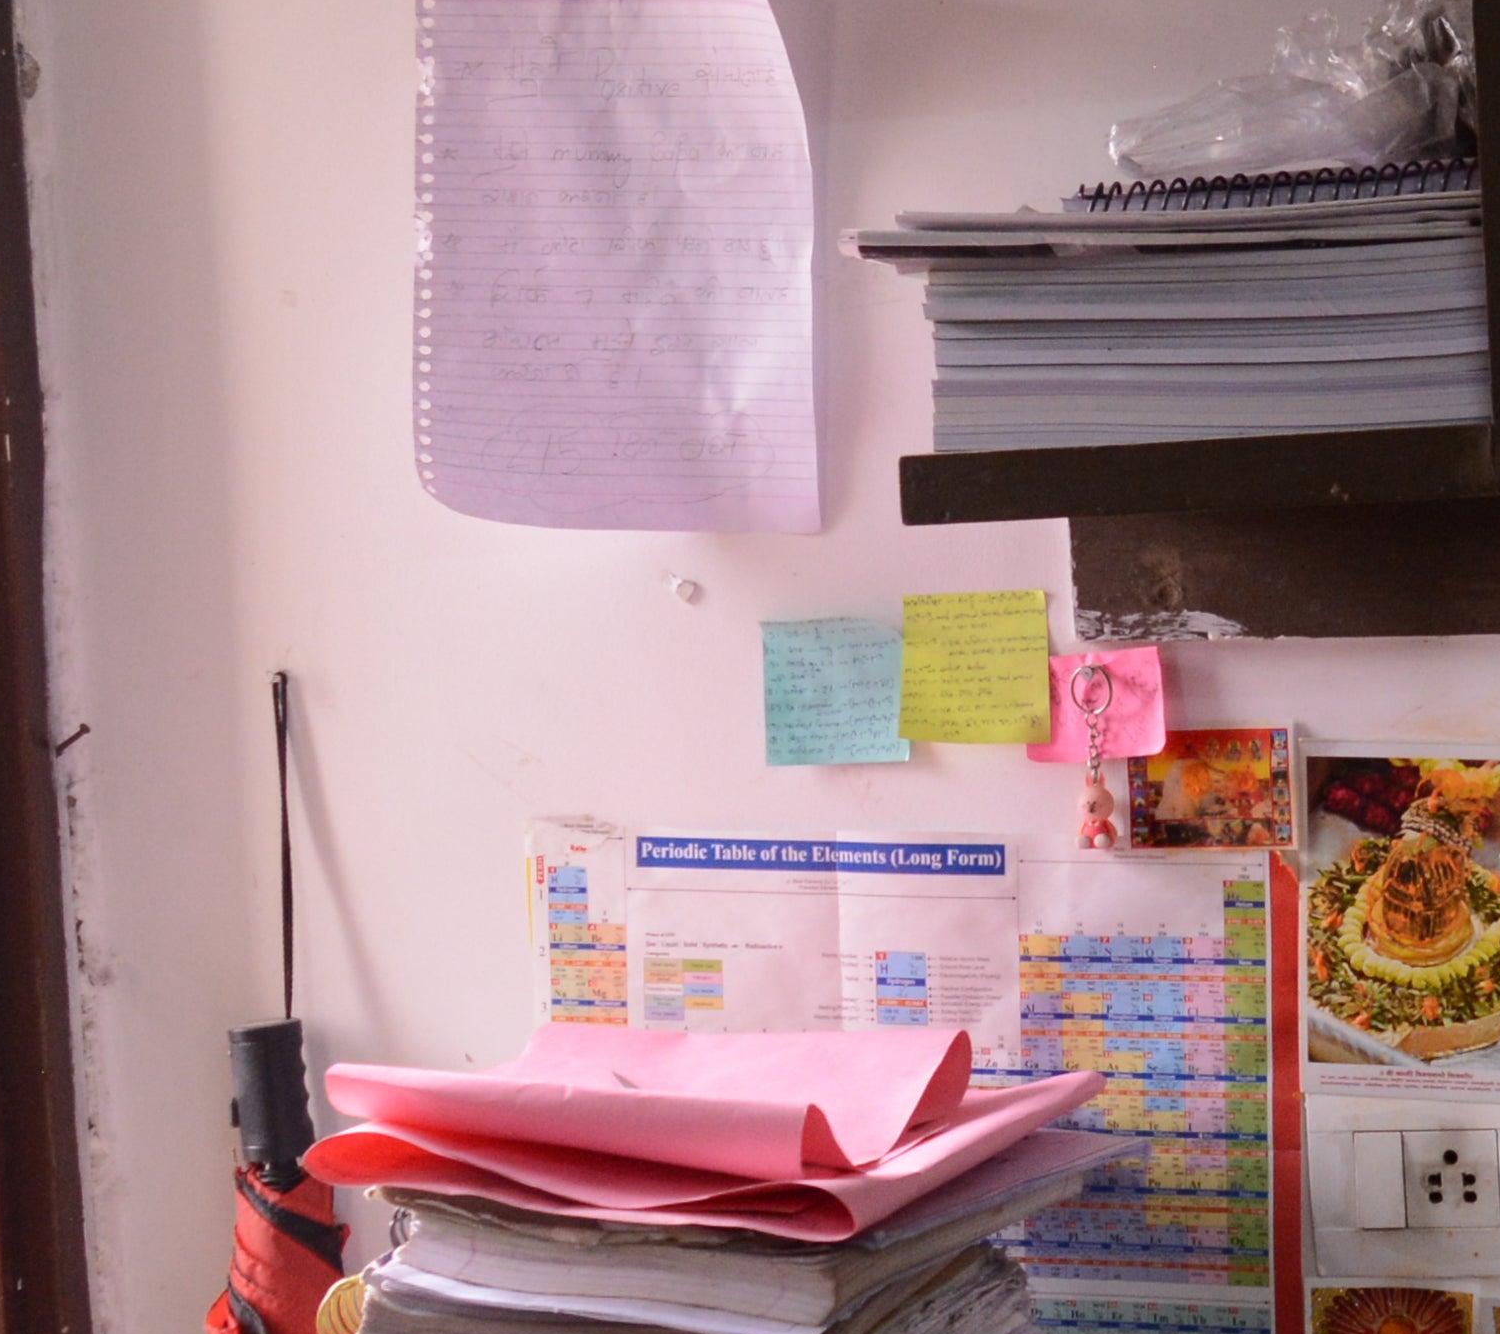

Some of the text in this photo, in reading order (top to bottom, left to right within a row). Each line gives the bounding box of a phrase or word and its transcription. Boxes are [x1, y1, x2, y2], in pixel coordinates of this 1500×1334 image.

[641, 842, 1002, 869] Periodic Table of the Elements (Long Form)
[880, 964, 888, 974] H
